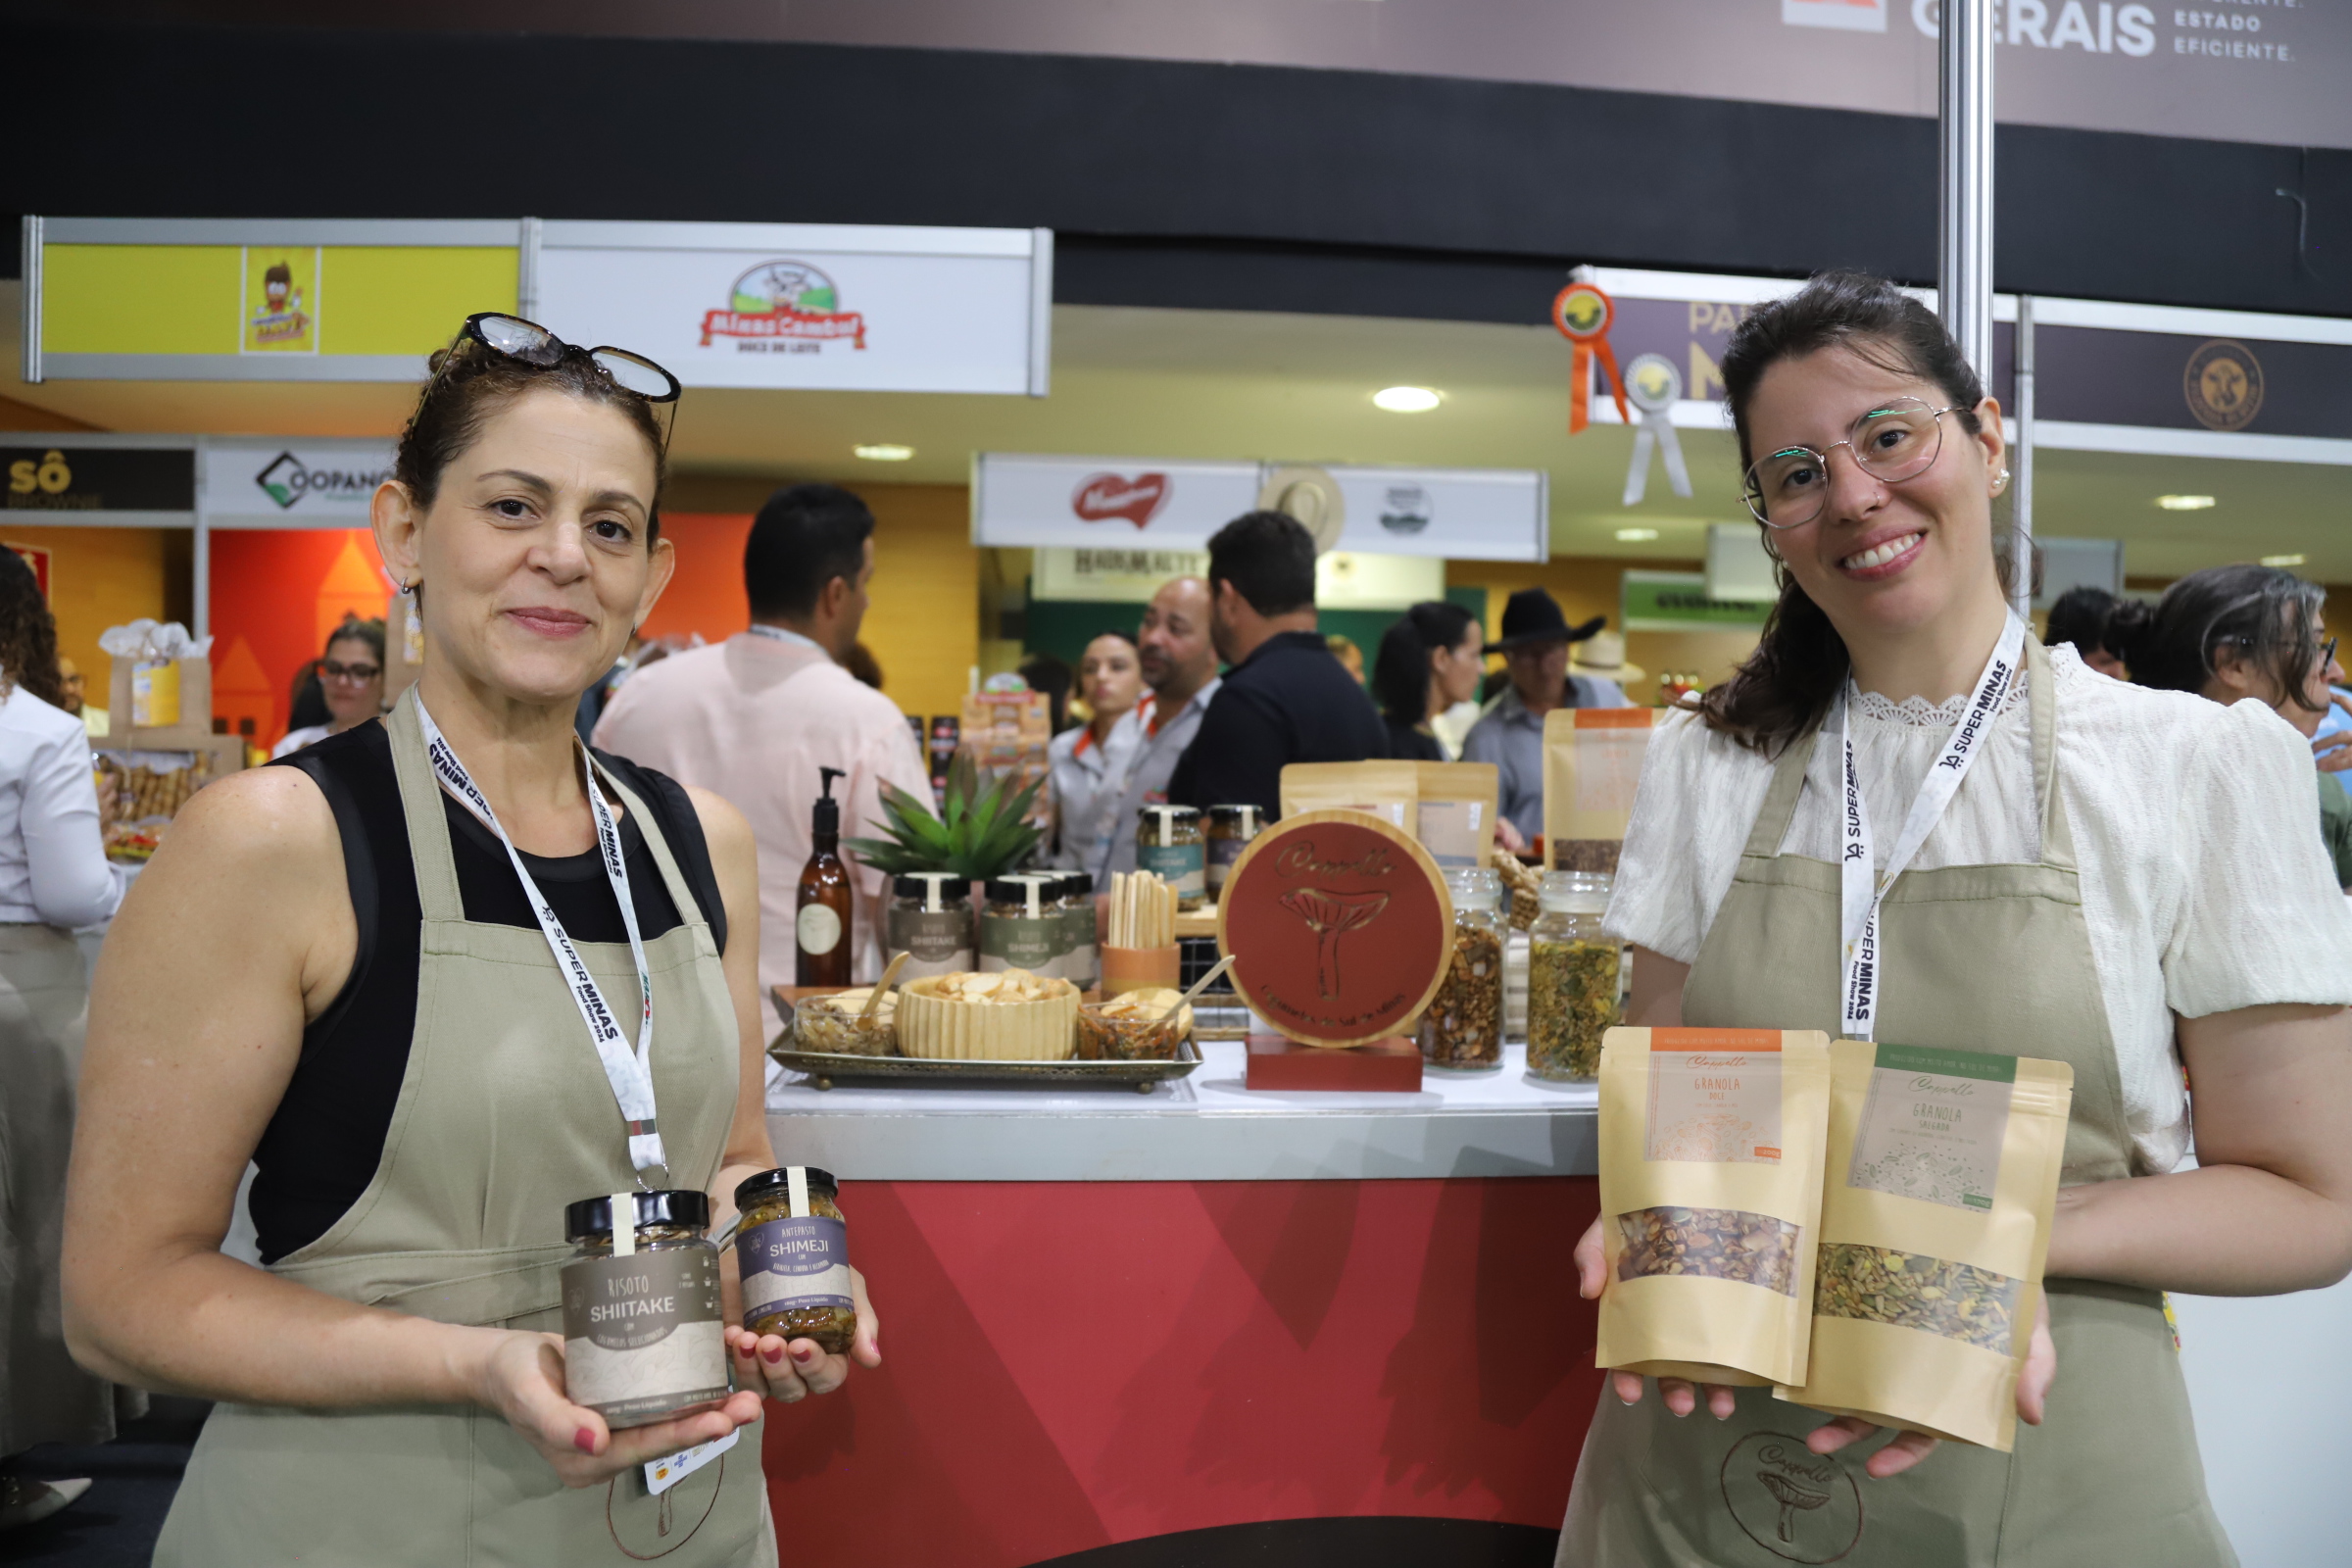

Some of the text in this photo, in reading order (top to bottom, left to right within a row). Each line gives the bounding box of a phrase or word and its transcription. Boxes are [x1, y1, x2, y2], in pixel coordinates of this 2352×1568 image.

[2175, 9, 2261, 32] ESTADO
[10, 448, 72, 494] SÔ
[1954, 660, 2007, 754] SUPER MINAS
[1989, 697, 2001, 712] Food
[1997, 682, 2008, 697] Show
[429, 743, 467, 791] MINAS
[445, 751, 458, 768] Show
[455, 765, 468, 781] Food
[1847, 787, 1862, 838] SUPER
[605, 829, 623, 879] MINAS
[1850, 960, 1860, 980] Food
[554, 927, 619, 1040] SUPER MINAS
[1848, 980, 1858, 1001] Show
[1855, 962, 1874, 1021] MINAS
[576, 985, 606, 1044] Food Show 2024
[1339, 1015, 1357, 1027] Sul
[1376, 992, 1406, 1015] Minas
[1686, 1054, 1749, 1070] Cappello
[1694, 1077, 1740, 1091] GRANOLA
[1908, 1075, 1976, 1097] Cappello
[1709, 1092, 1725, 1101] DOCE
[1913, 1102, 1962, 1123] GRANOLA
[1919, 1120, 1950, 1132] SALGADA
[781, 1225, 816, 1238] ANTEPASTO
[769, 1239, 829, 1257] SHIMEJI
[608, 1275, 649, 1298] RISOTO
[591, 1296, 675, 1323] SHIITAKE
